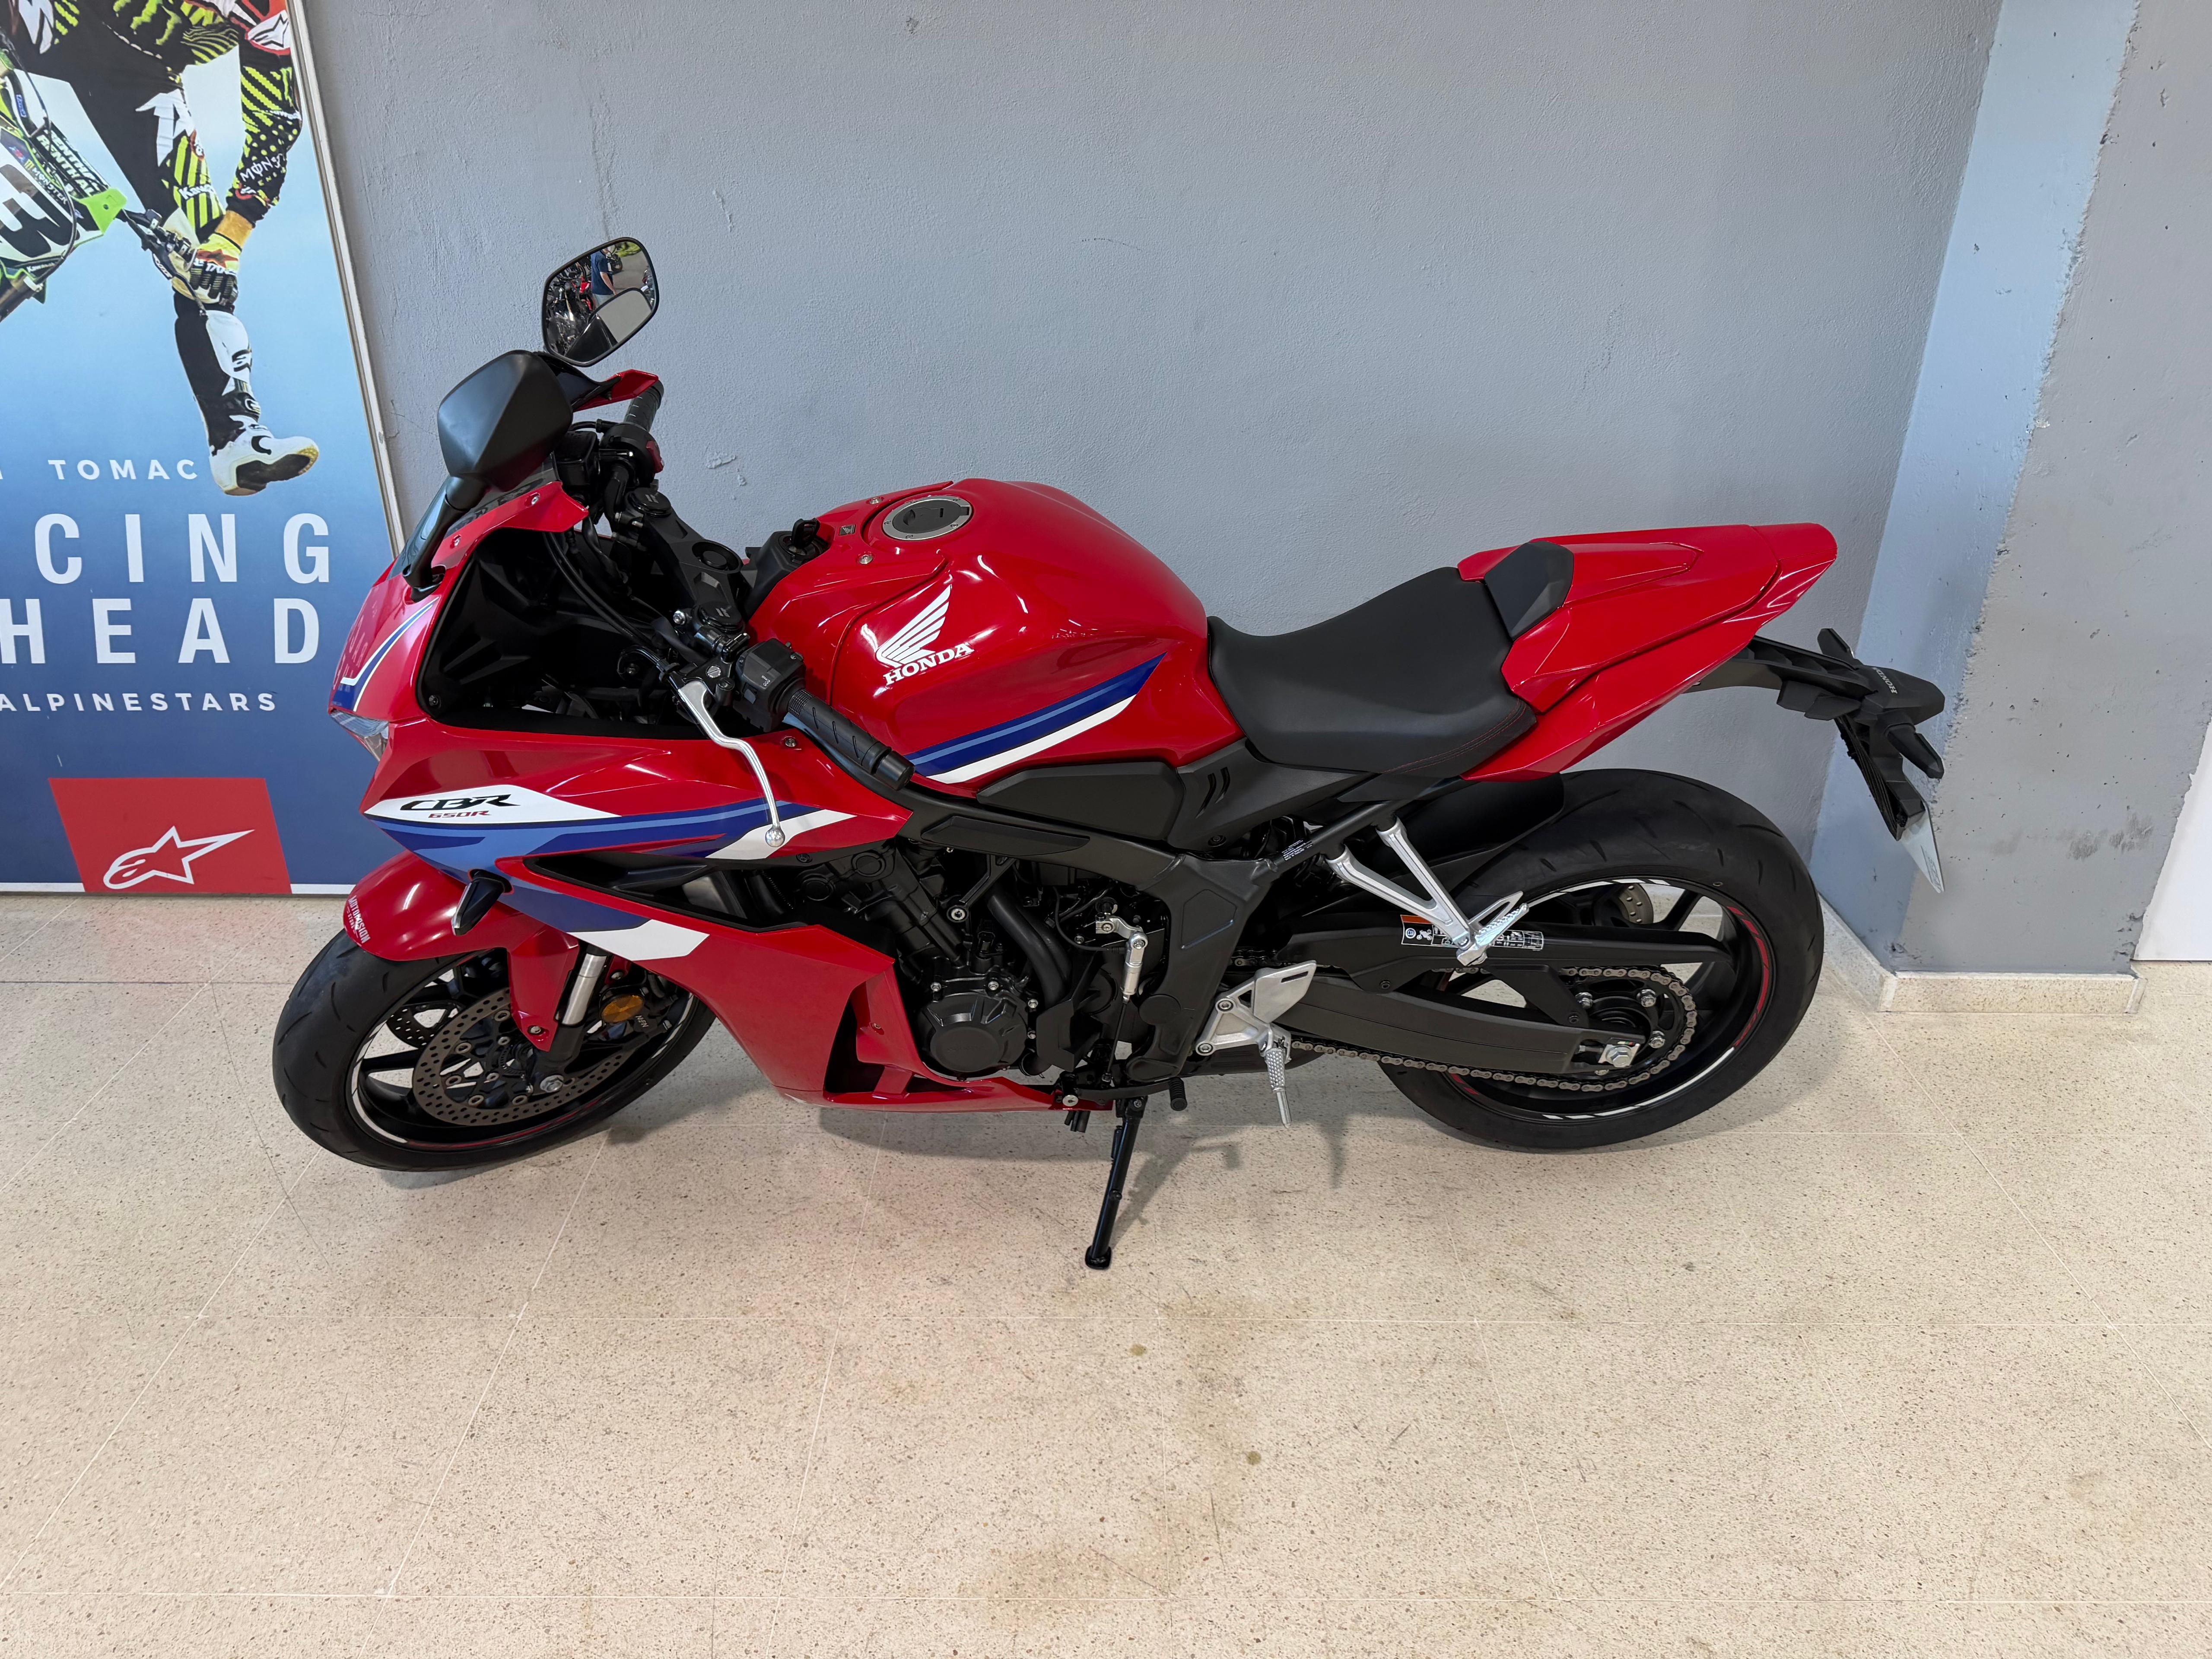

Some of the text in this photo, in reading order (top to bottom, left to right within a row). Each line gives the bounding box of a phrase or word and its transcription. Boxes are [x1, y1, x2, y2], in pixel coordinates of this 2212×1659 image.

[48, 459, 197, 480] TOMAC
[34, 513, 330, 584] CING
[0, 598, 319, 664] HEAD
[883, 643, 975, 686] HONDA
[0, 693, 276, 712] ALPINESTARS
[400, 794, 521, 810] CBR
